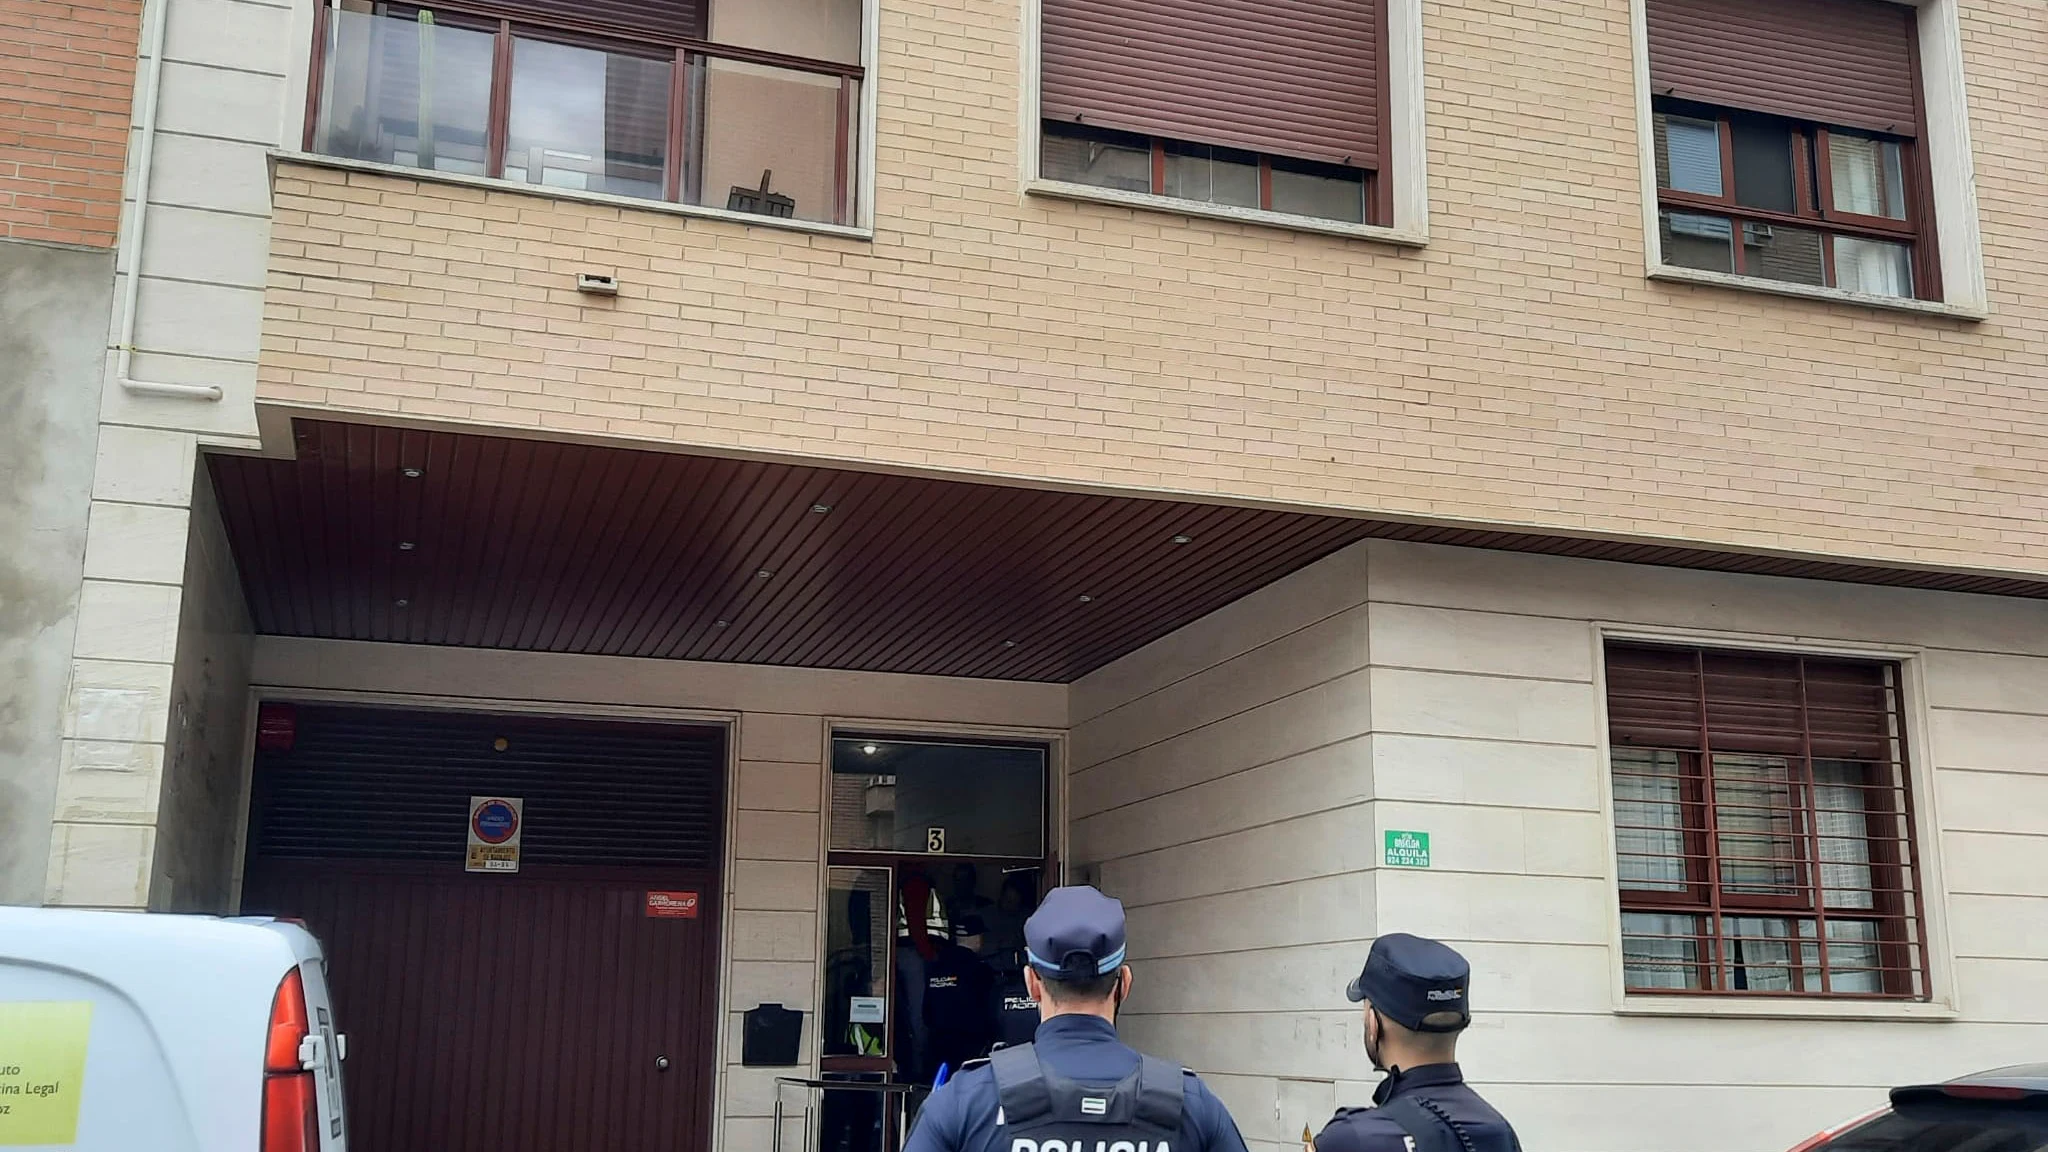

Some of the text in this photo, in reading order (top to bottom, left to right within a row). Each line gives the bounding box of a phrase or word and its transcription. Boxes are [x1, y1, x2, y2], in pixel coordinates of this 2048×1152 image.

[930, 830, 943, 851] 3
[1387, 848, 1428, 858] ALQUILA
[0, 1081, 59, 1098] ina Legal
